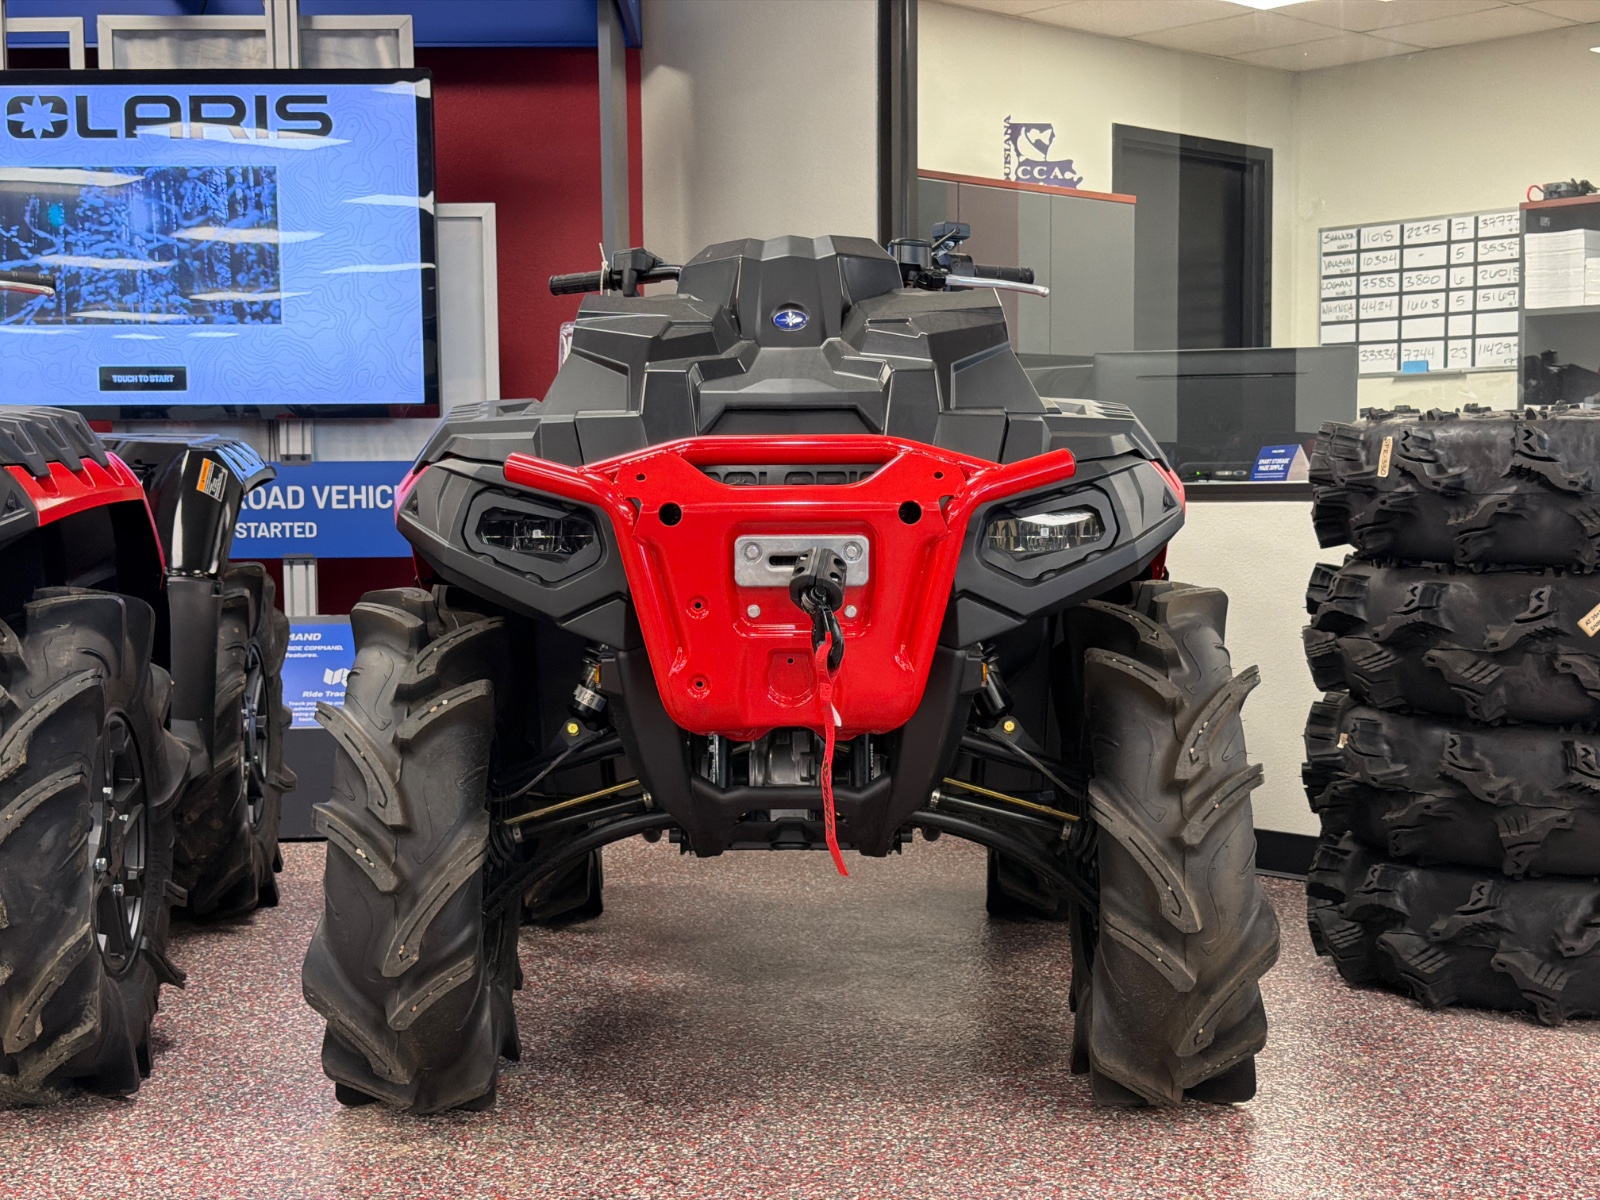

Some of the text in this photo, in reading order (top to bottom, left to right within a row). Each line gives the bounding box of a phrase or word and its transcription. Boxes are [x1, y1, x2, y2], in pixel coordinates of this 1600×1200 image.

[1017, 166, 1063, 179] CCA
[1406, 223, 1442, 239] 2275
[1455, 222, 1468, 234] 7
[1363, 253, 1397, 266] 10304
[1456, 247, 1466, 260] 5
[1362, 277, 1396, 288] 7588
[1405, 274, 1440, 288] 3800
[1361, 300, 1393, 313] 4424
[1456, 295, 1465, 306] 5
[1404, 347, 1435, 361] 7744
[1450, 347, 1468, 359] 23
[111, 375, 175, 383] TOUCH TO START
[235, 522, 318, 539] STARTED
